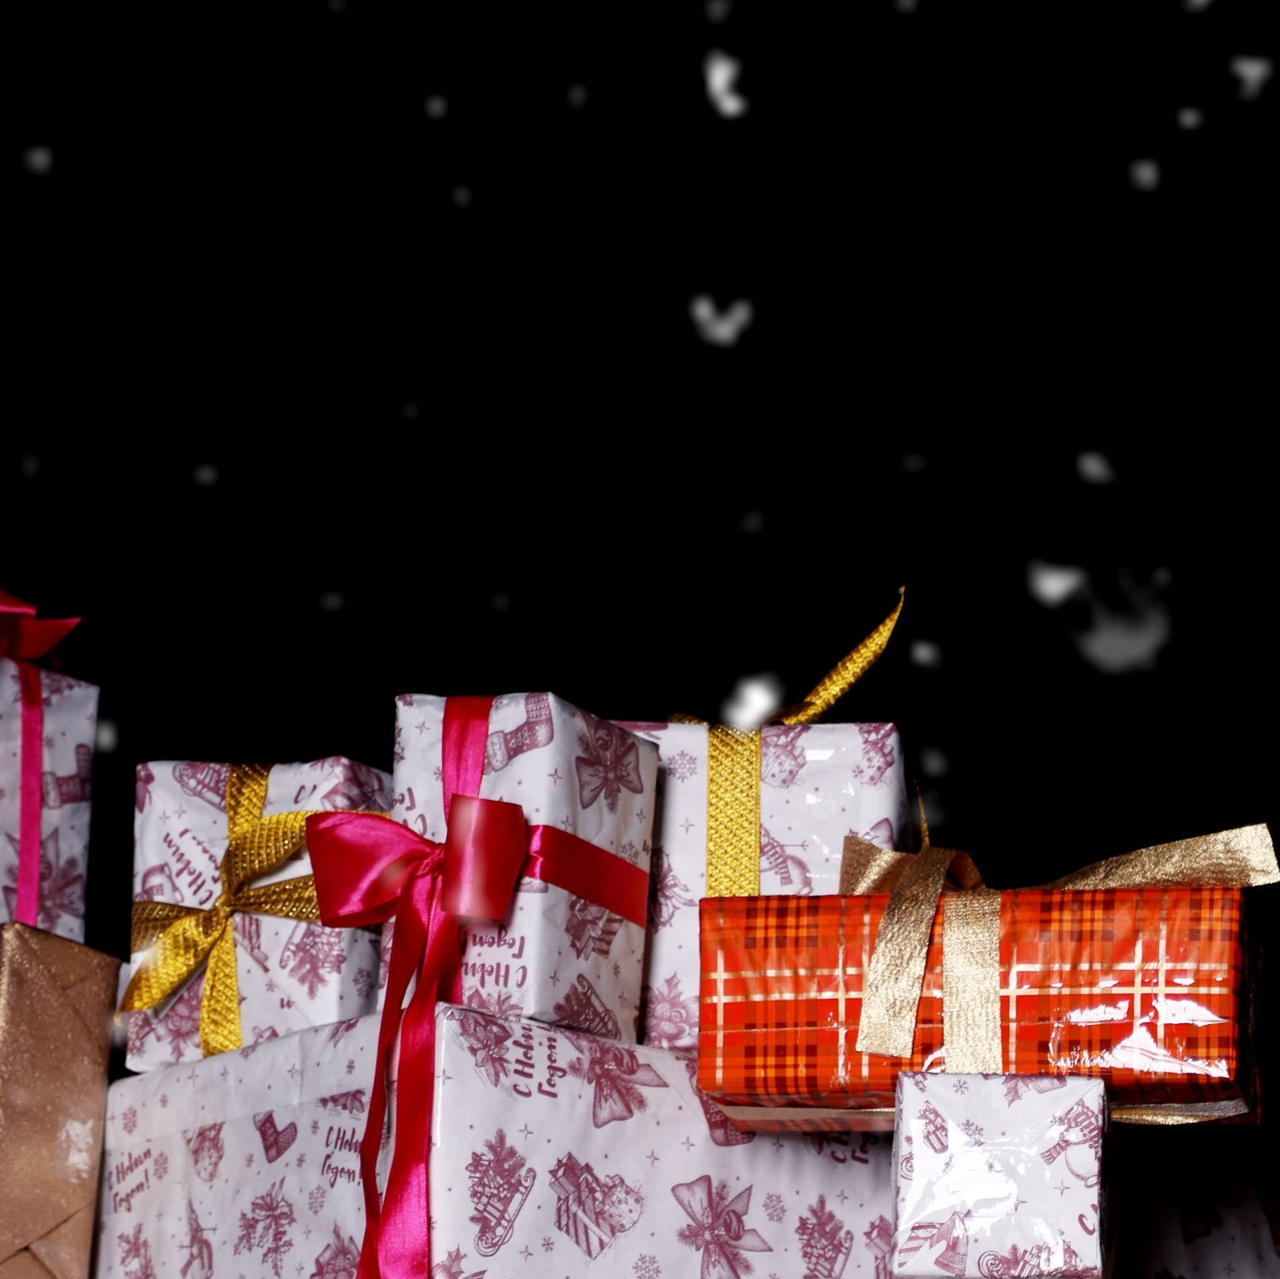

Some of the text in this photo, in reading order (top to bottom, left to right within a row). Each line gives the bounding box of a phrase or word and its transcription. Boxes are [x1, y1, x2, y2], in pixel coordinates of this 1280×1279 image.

[462, 962, 510, 989] Новы
[512, 1025, 535, 1098] С Новы
